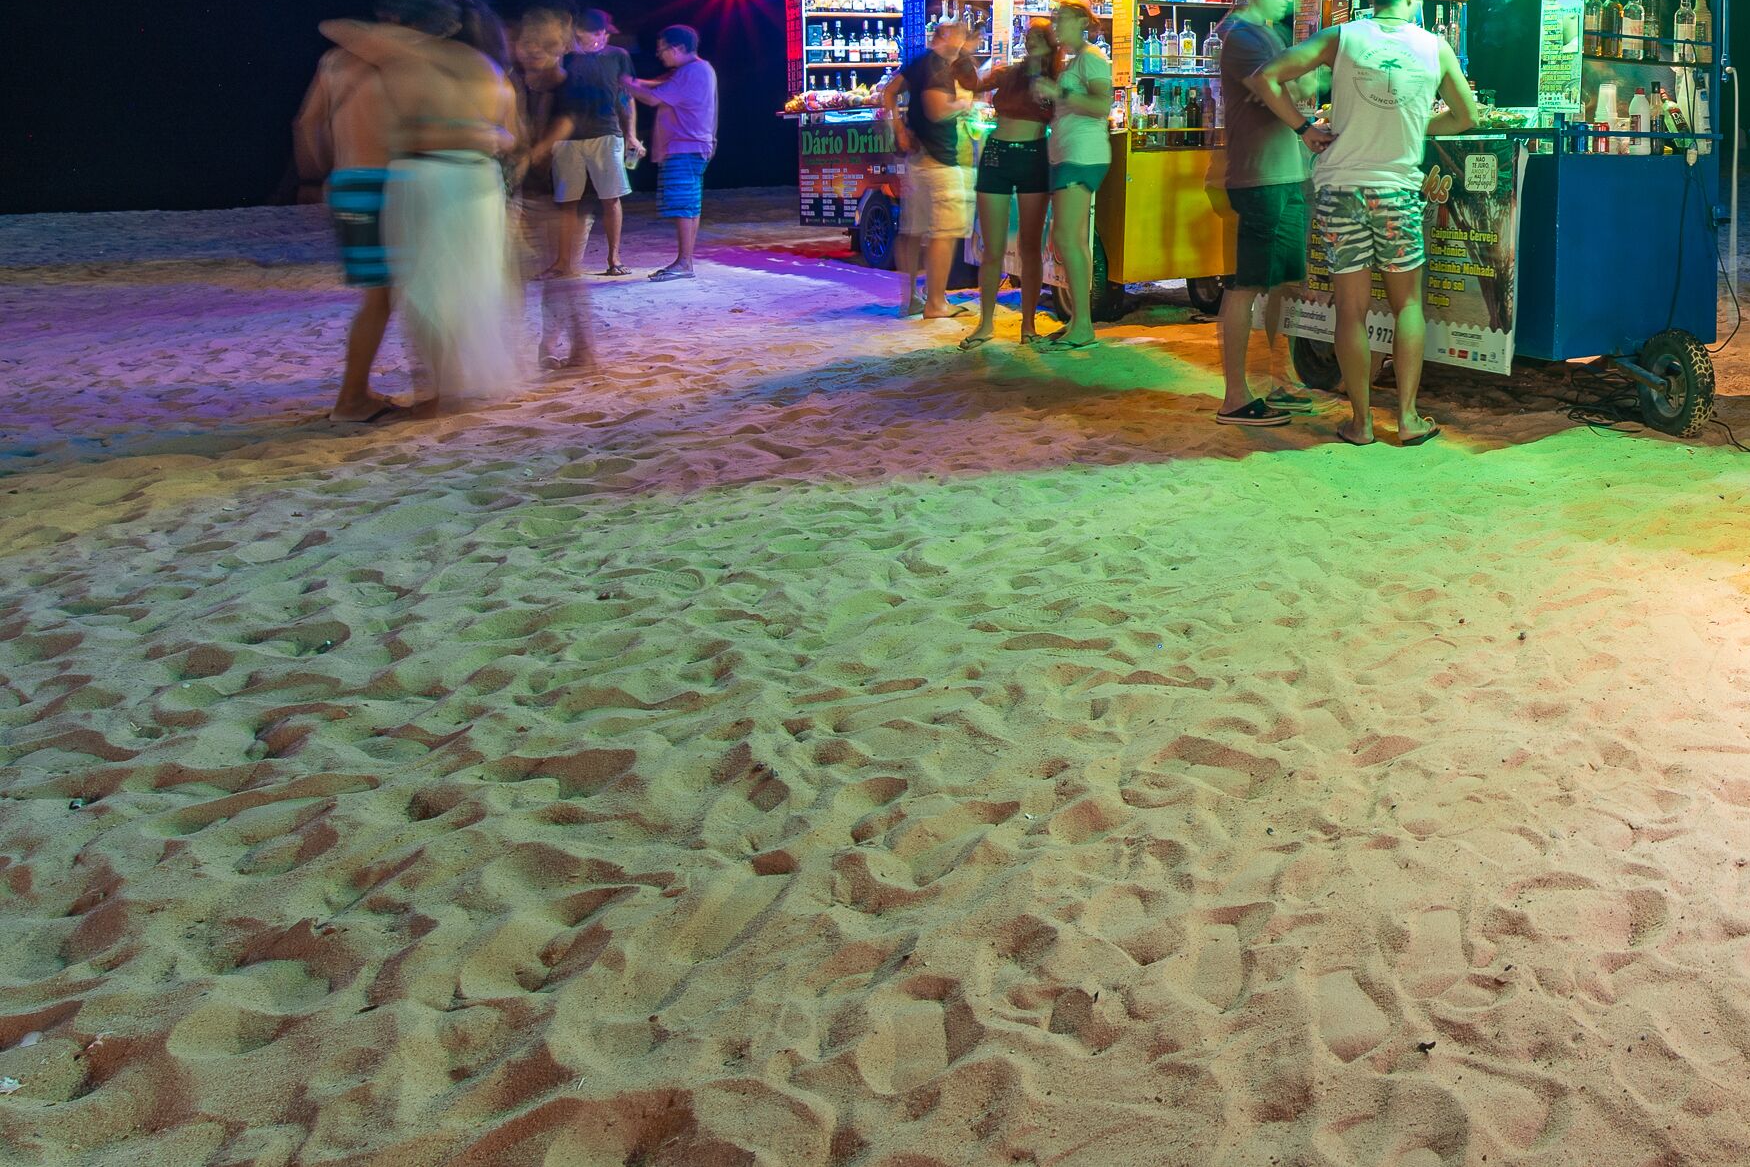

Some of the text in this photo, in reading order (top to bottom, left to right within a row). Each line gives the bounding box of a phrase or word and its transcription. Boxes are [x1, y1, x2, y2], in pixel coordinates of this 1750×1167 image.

[802, 129, 843, 155] Dário
[1431, 226, 1498, 245] Caipirinha Cerveja
